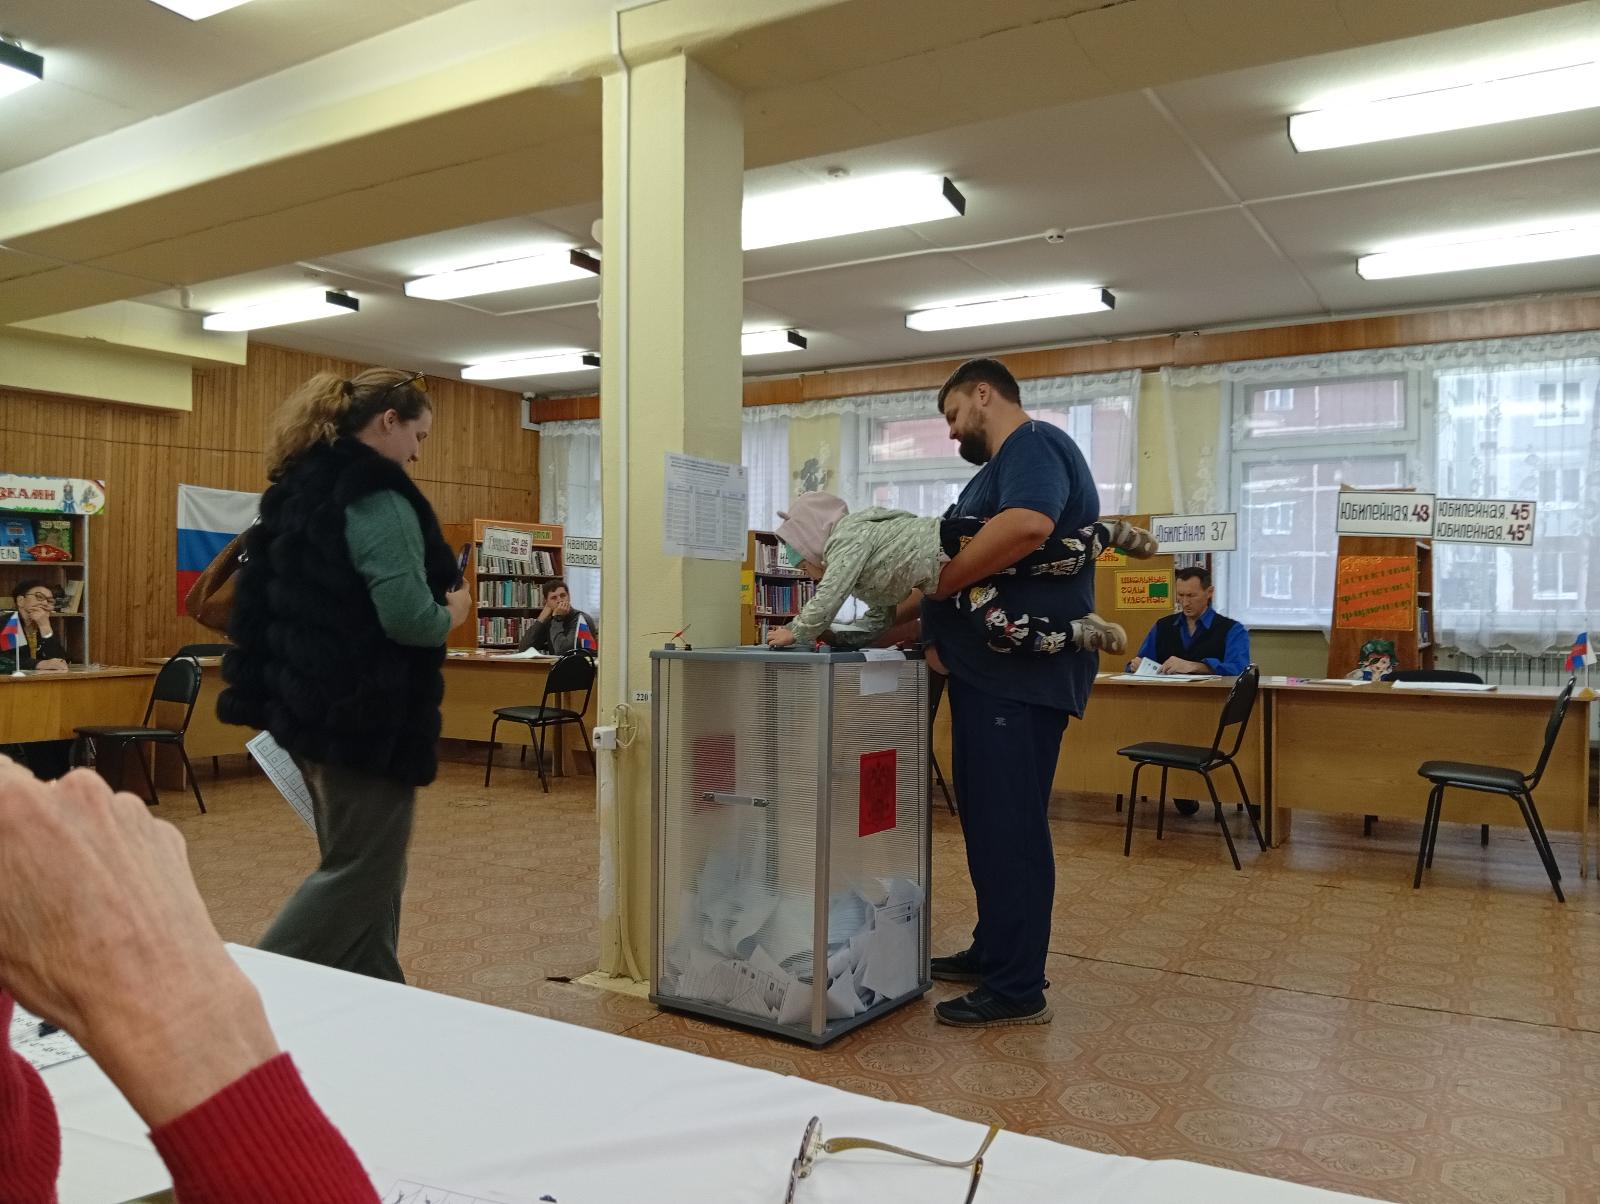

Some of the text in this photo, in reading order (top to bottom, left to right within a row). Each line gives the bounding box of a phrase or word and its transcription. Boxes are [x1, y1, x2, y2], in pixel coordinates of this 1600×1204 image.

[1412, 504, 1430, 522] 43
[1511, 503, 1531, 520] 45
[1210, 521, 1228, 541] 37
